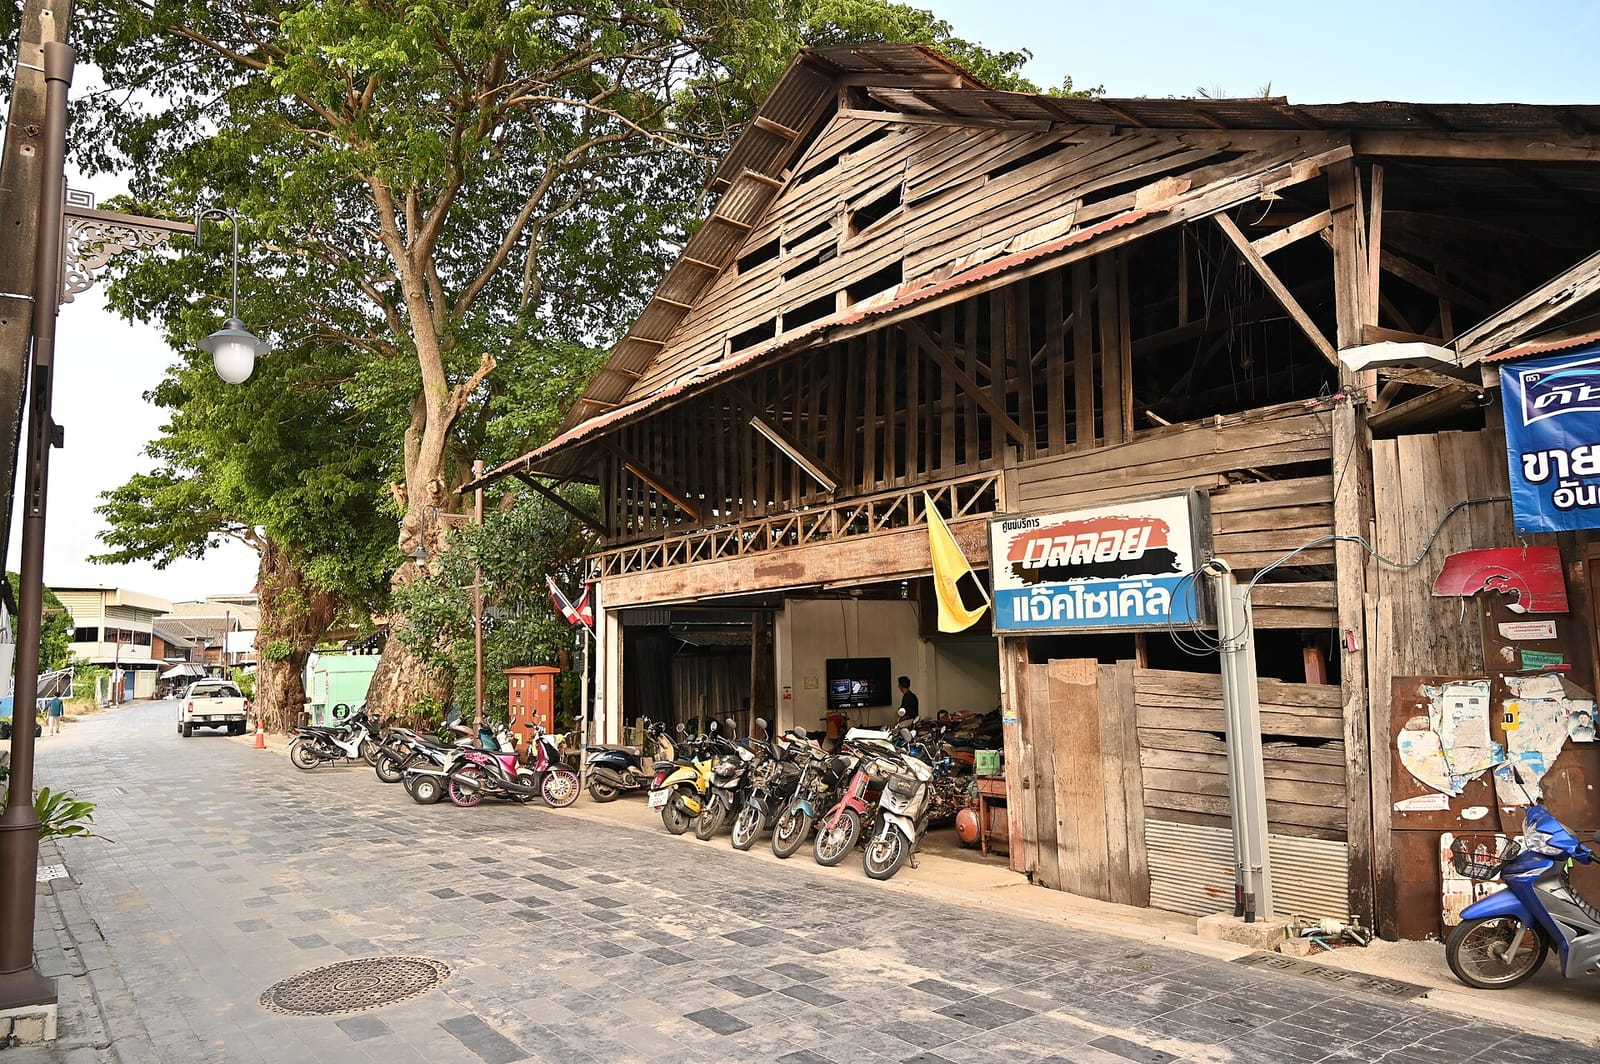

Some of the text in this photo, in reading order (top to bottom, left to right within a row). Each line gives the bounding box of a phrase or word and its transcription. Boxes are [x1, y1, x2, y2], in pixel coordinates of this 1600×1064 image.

[1553, 479, 1600, 508] อัน
[1022, 525, 1153, 569] เวลลอย
[1012, 580, 1171, 622] แจ๊คไซเคิ้ล
